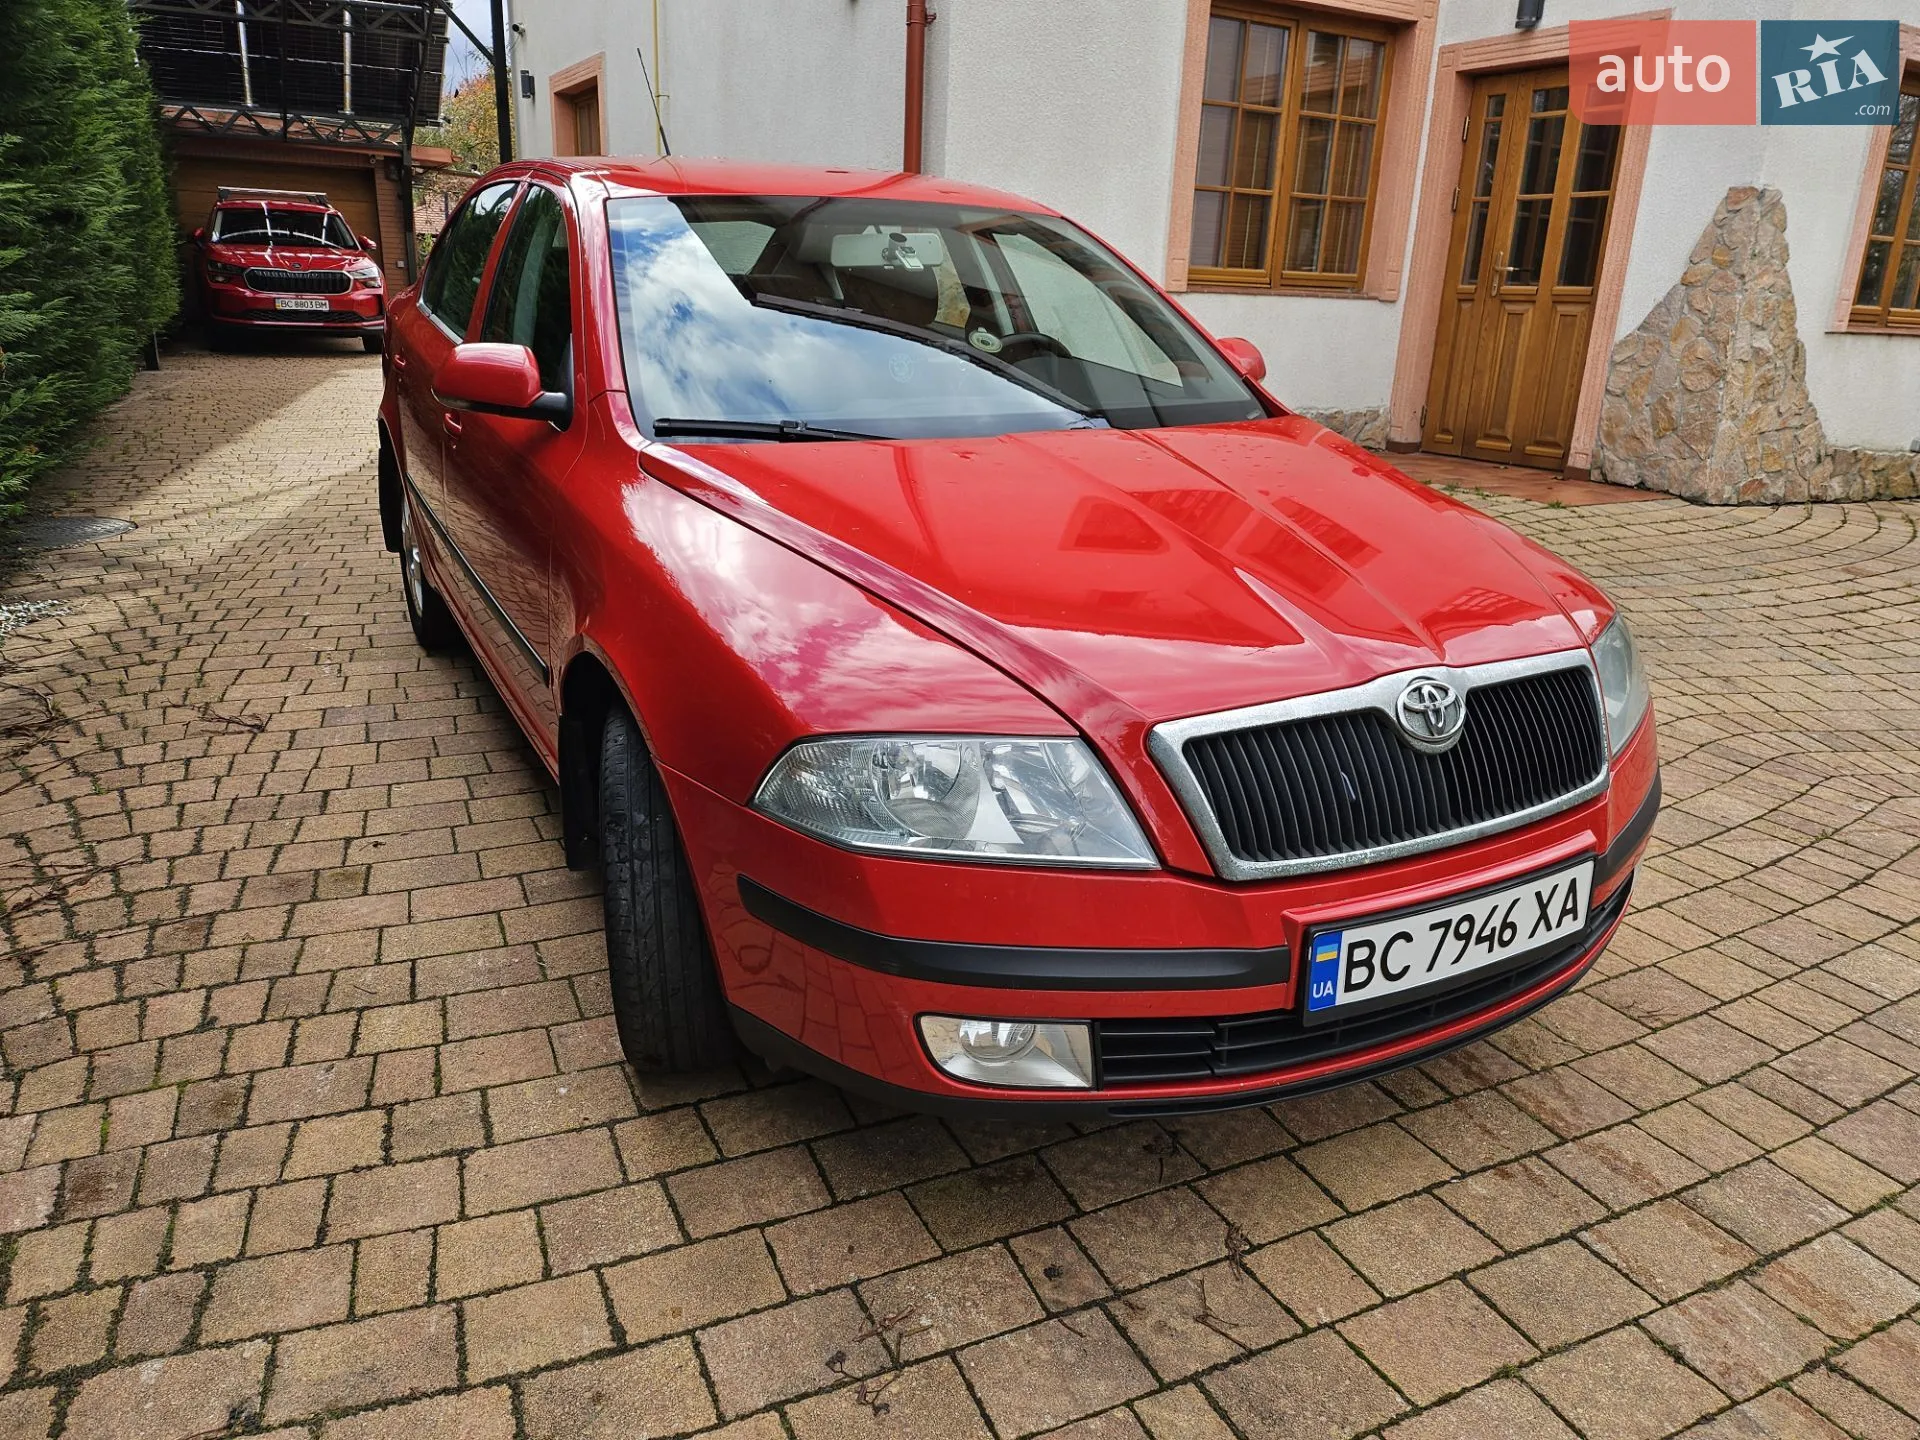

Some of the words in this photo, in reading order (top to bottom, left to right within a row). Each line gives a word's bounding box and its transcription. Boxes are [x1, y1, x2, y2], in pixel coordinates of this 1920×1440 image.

[280, 300, 293, 308] BC
[294, 301, 314, 309] 8803
[315, 301, 328, 309] BM
[1344, 930, 1414, 994] BC
[1426, 897, 1521, 973] 7946
[1528, 877, 1579, 940] XA
[1312, 980, 1335, 999] UA
